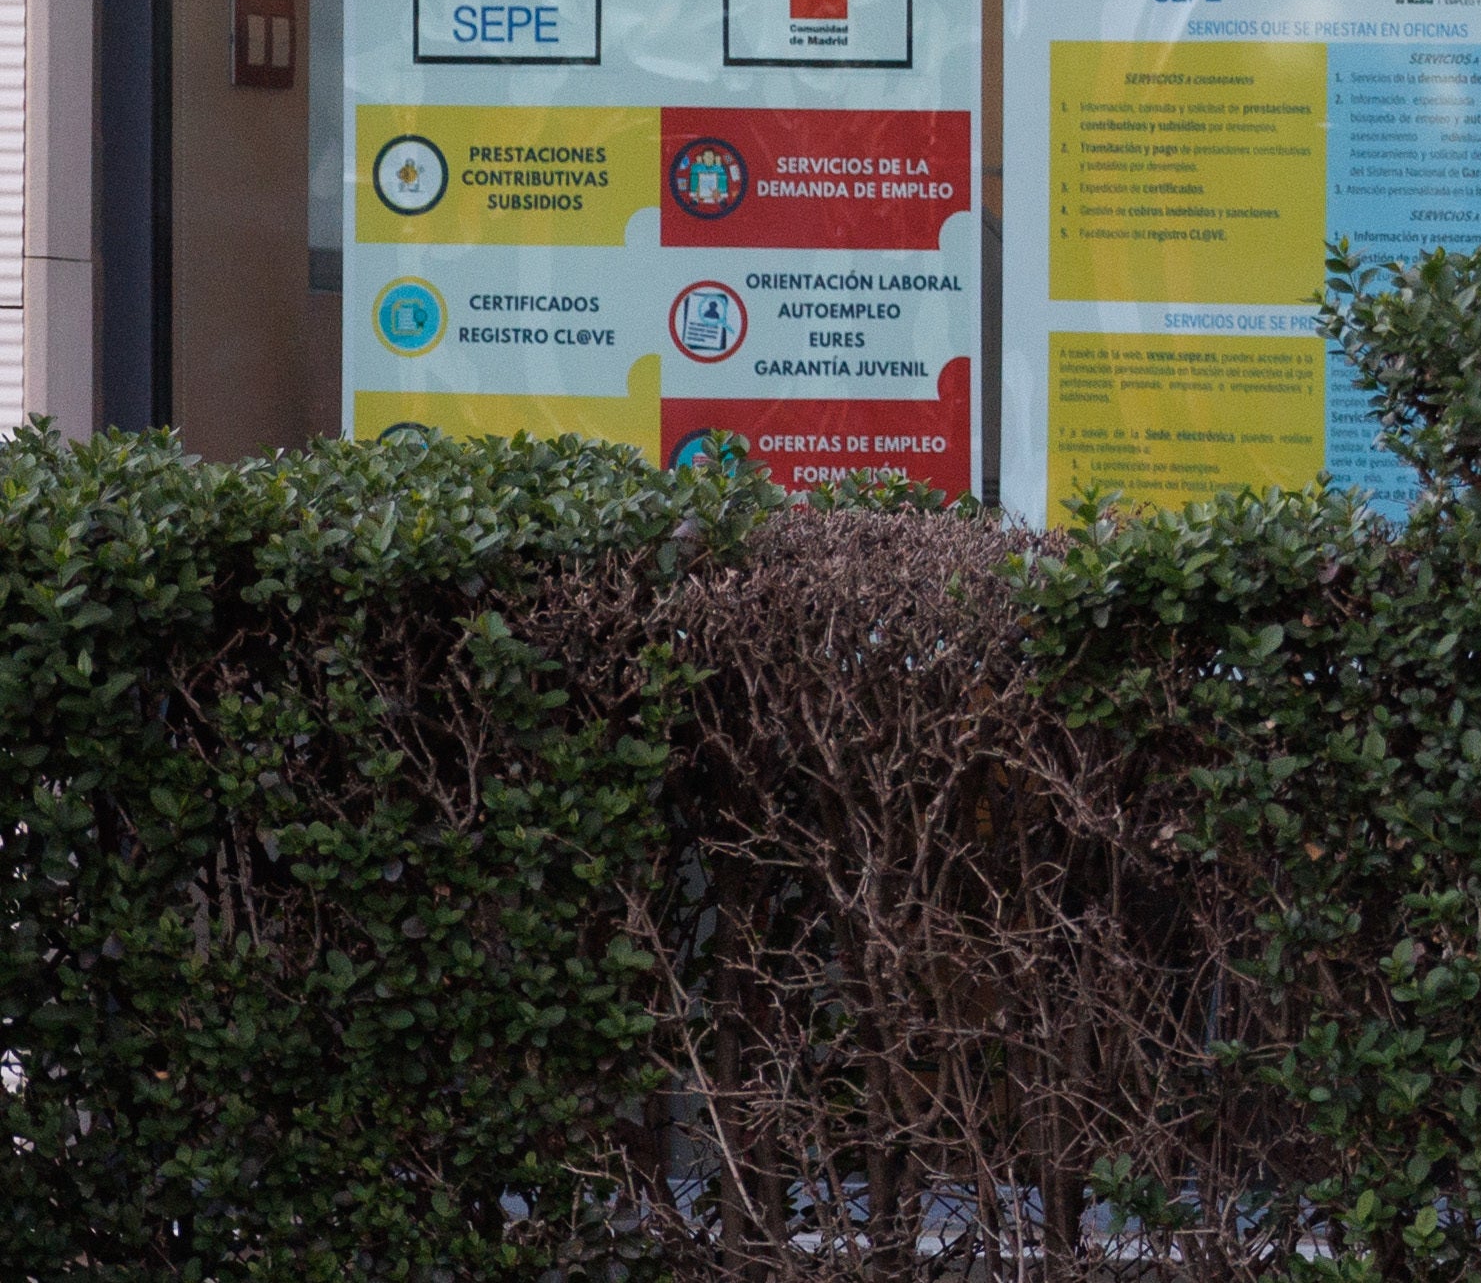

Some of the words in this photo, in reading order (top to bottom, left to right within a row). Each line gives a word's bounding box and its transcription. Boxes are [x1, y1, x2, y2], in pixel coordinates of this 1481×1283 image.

[452, 5, 559, 43] SEPE
[469, 146, 607, 164] PRESTACIONES
[777, 157, 872, 176] SERVICIOS
[879, 157, 901, 175] DE
[907, 157, 929, 175] LA
[462, 170, 609, 188] CONTRIBUTIVAS
[757, 180, 848, 199] DEMANDA
[853, 181, 875, 199] DE
[880, 181, 954, 200] EMPLEO
[486, 193, 584, 211] SUBSIDIOS
[746, 269, 873, 291] ORIENTACIÓN
[878, 272, 962, 292] LABORAL
[469, 294, 600, 313] CERTIFICADOS
[778, 302, 900, 319] AUTOEMPLEO
[458, 327, 549, 345] REGISTRO
[553, 327, 615, 346] CL@VE
[809, 331, 866, 348] EURES
[755, 355, 851, 377] GARANTÍA
[854, 360, 929, 377] JUVENIL
[759, 436, 841, 452] OFERTAS
[847, 436, 869, 452] DE
[874, 436, 947, 453] EMPLEO
